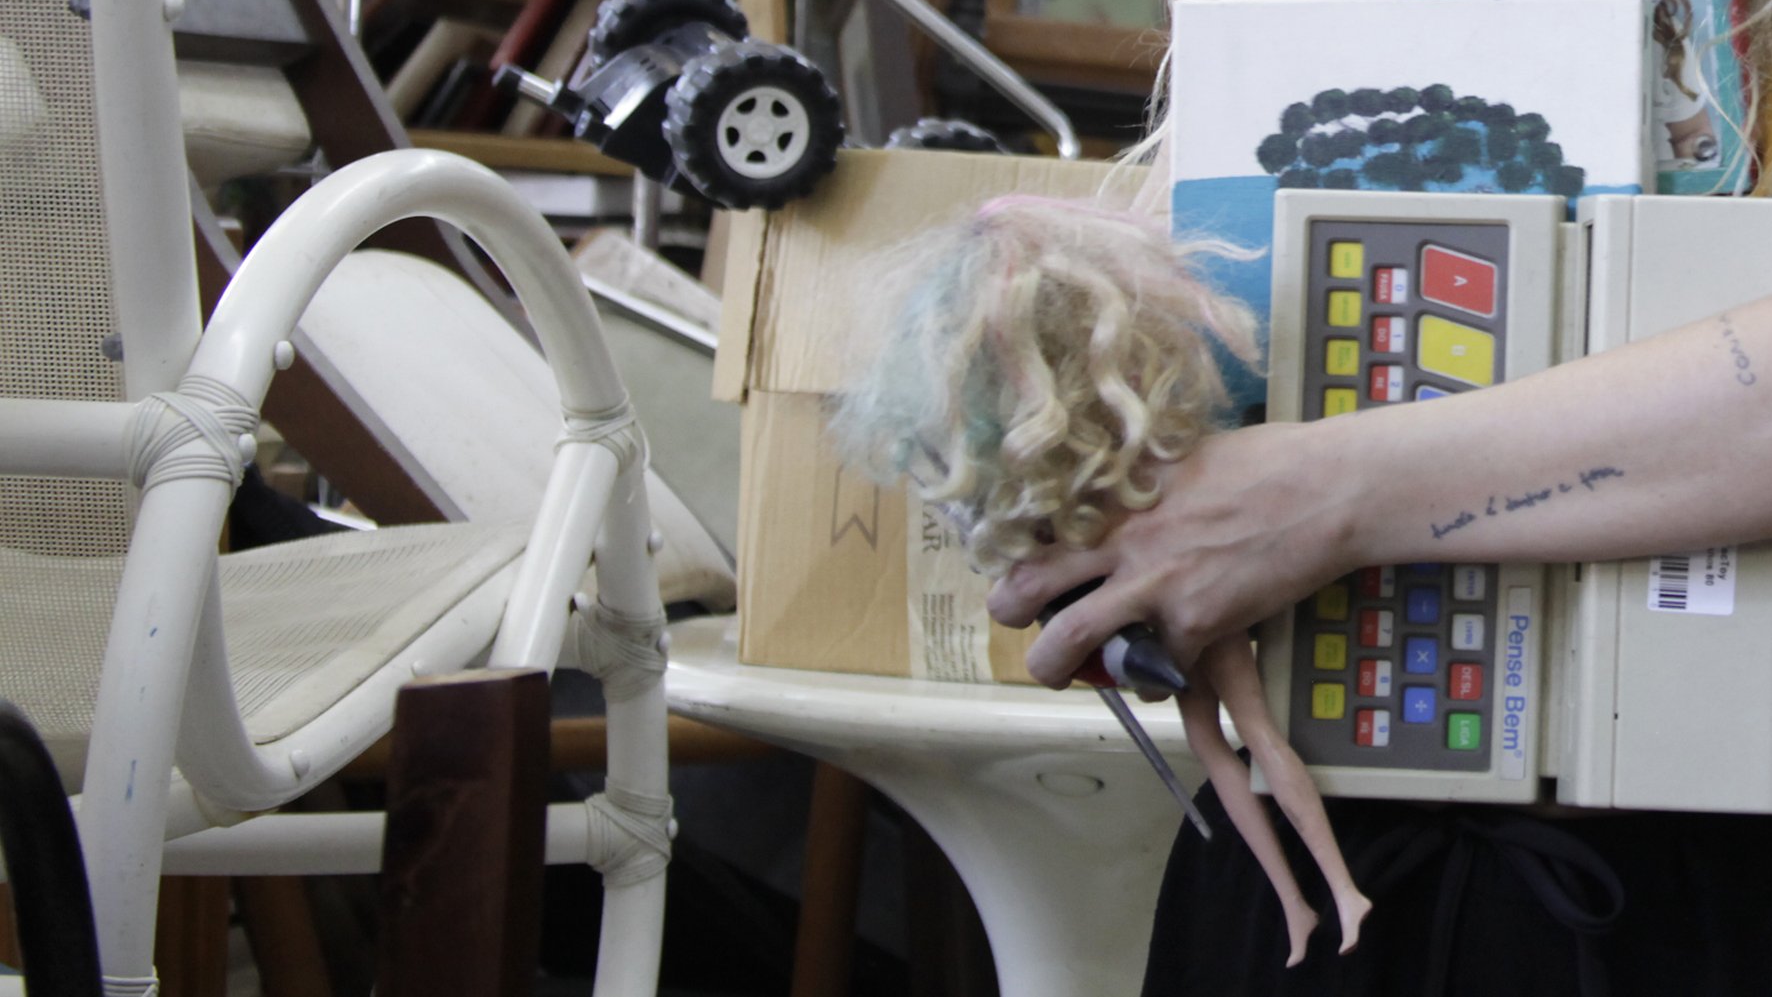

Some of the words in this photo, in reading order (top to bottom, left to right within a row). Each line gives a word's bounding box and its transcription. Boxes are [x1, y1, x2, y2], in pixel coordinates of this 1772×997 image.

[1379, 273, 1389, 301] PAUSA
[1453, 275, 1468, 287] A
[1504, 615, 1529, 687] Pense
[1459, 719, 1471, 747] LIGA
